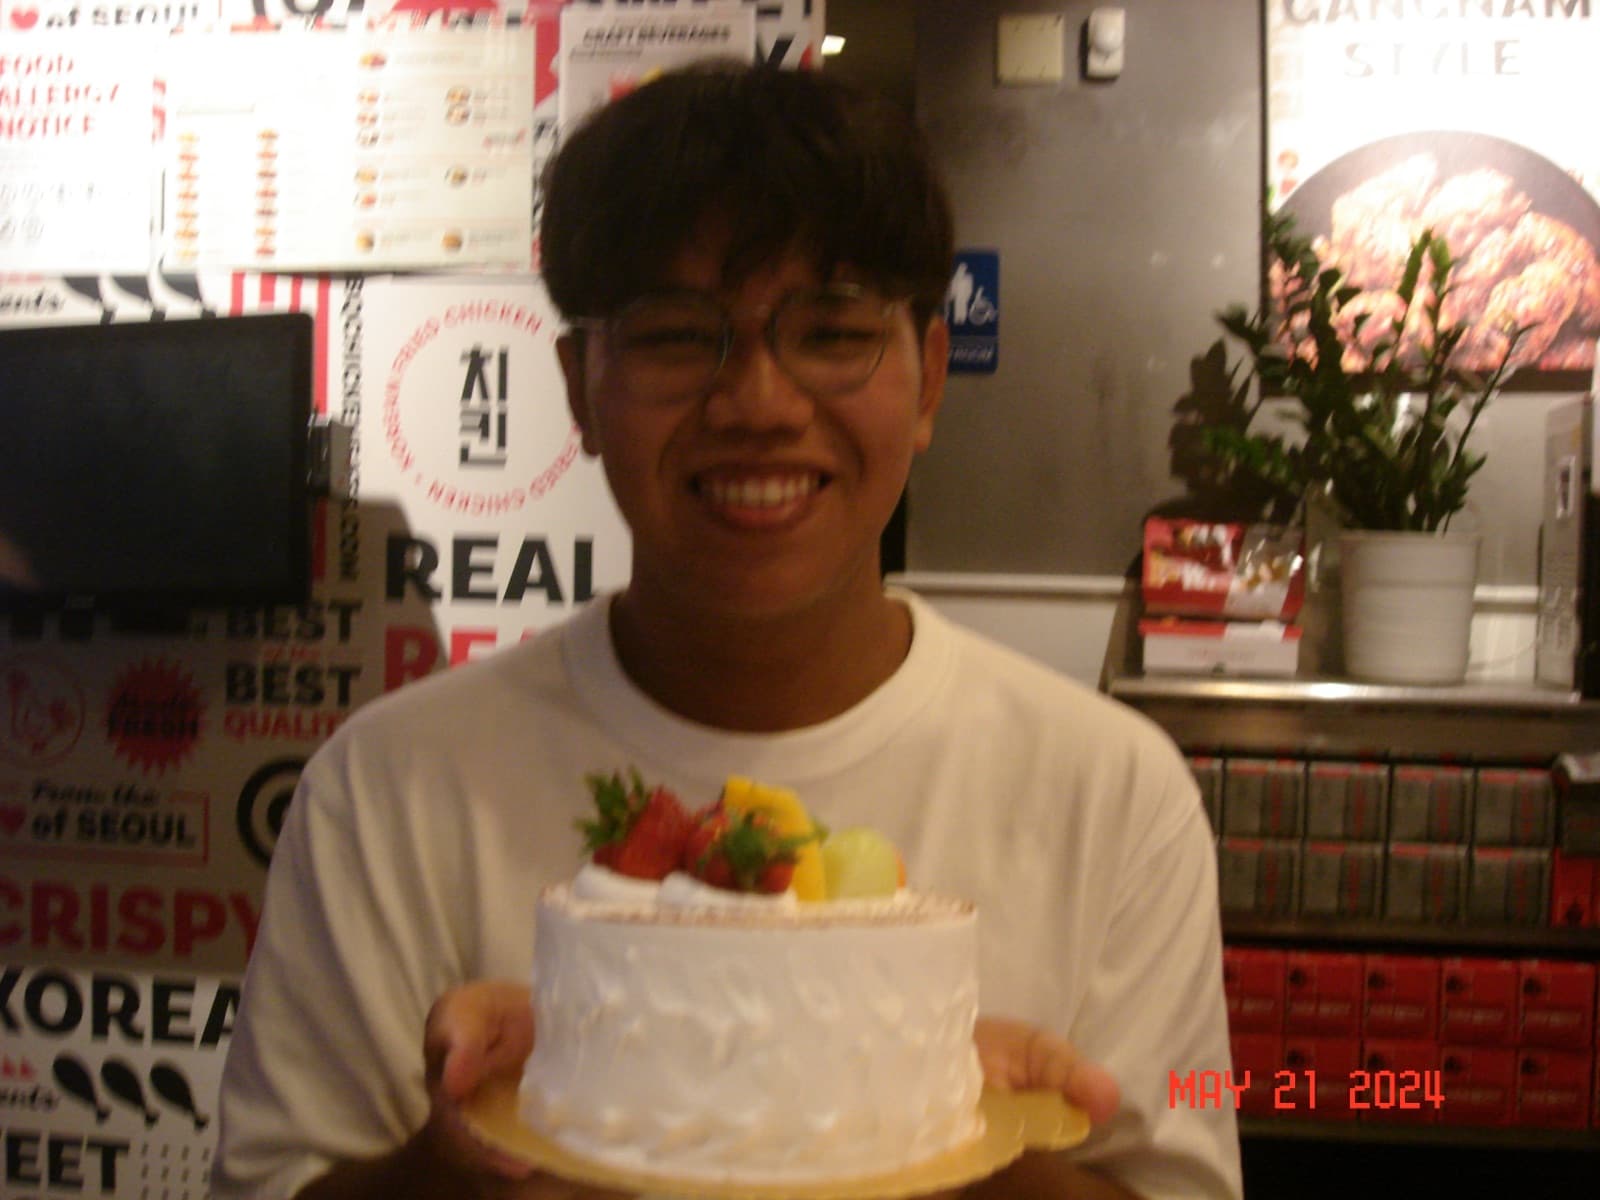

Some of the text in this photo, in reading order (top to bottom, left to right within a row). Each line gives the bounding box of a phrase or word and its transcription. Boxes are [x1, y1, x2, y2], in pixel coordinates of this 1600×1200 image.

[1343, 40, 1521, 77] STYLE
[459, 345, 509, 468] 치킨
[226, 663, 363, 707] BEST
[224, 709, 344, 742] QUALIT
[32, 809, 195, 850] of SEOUL
